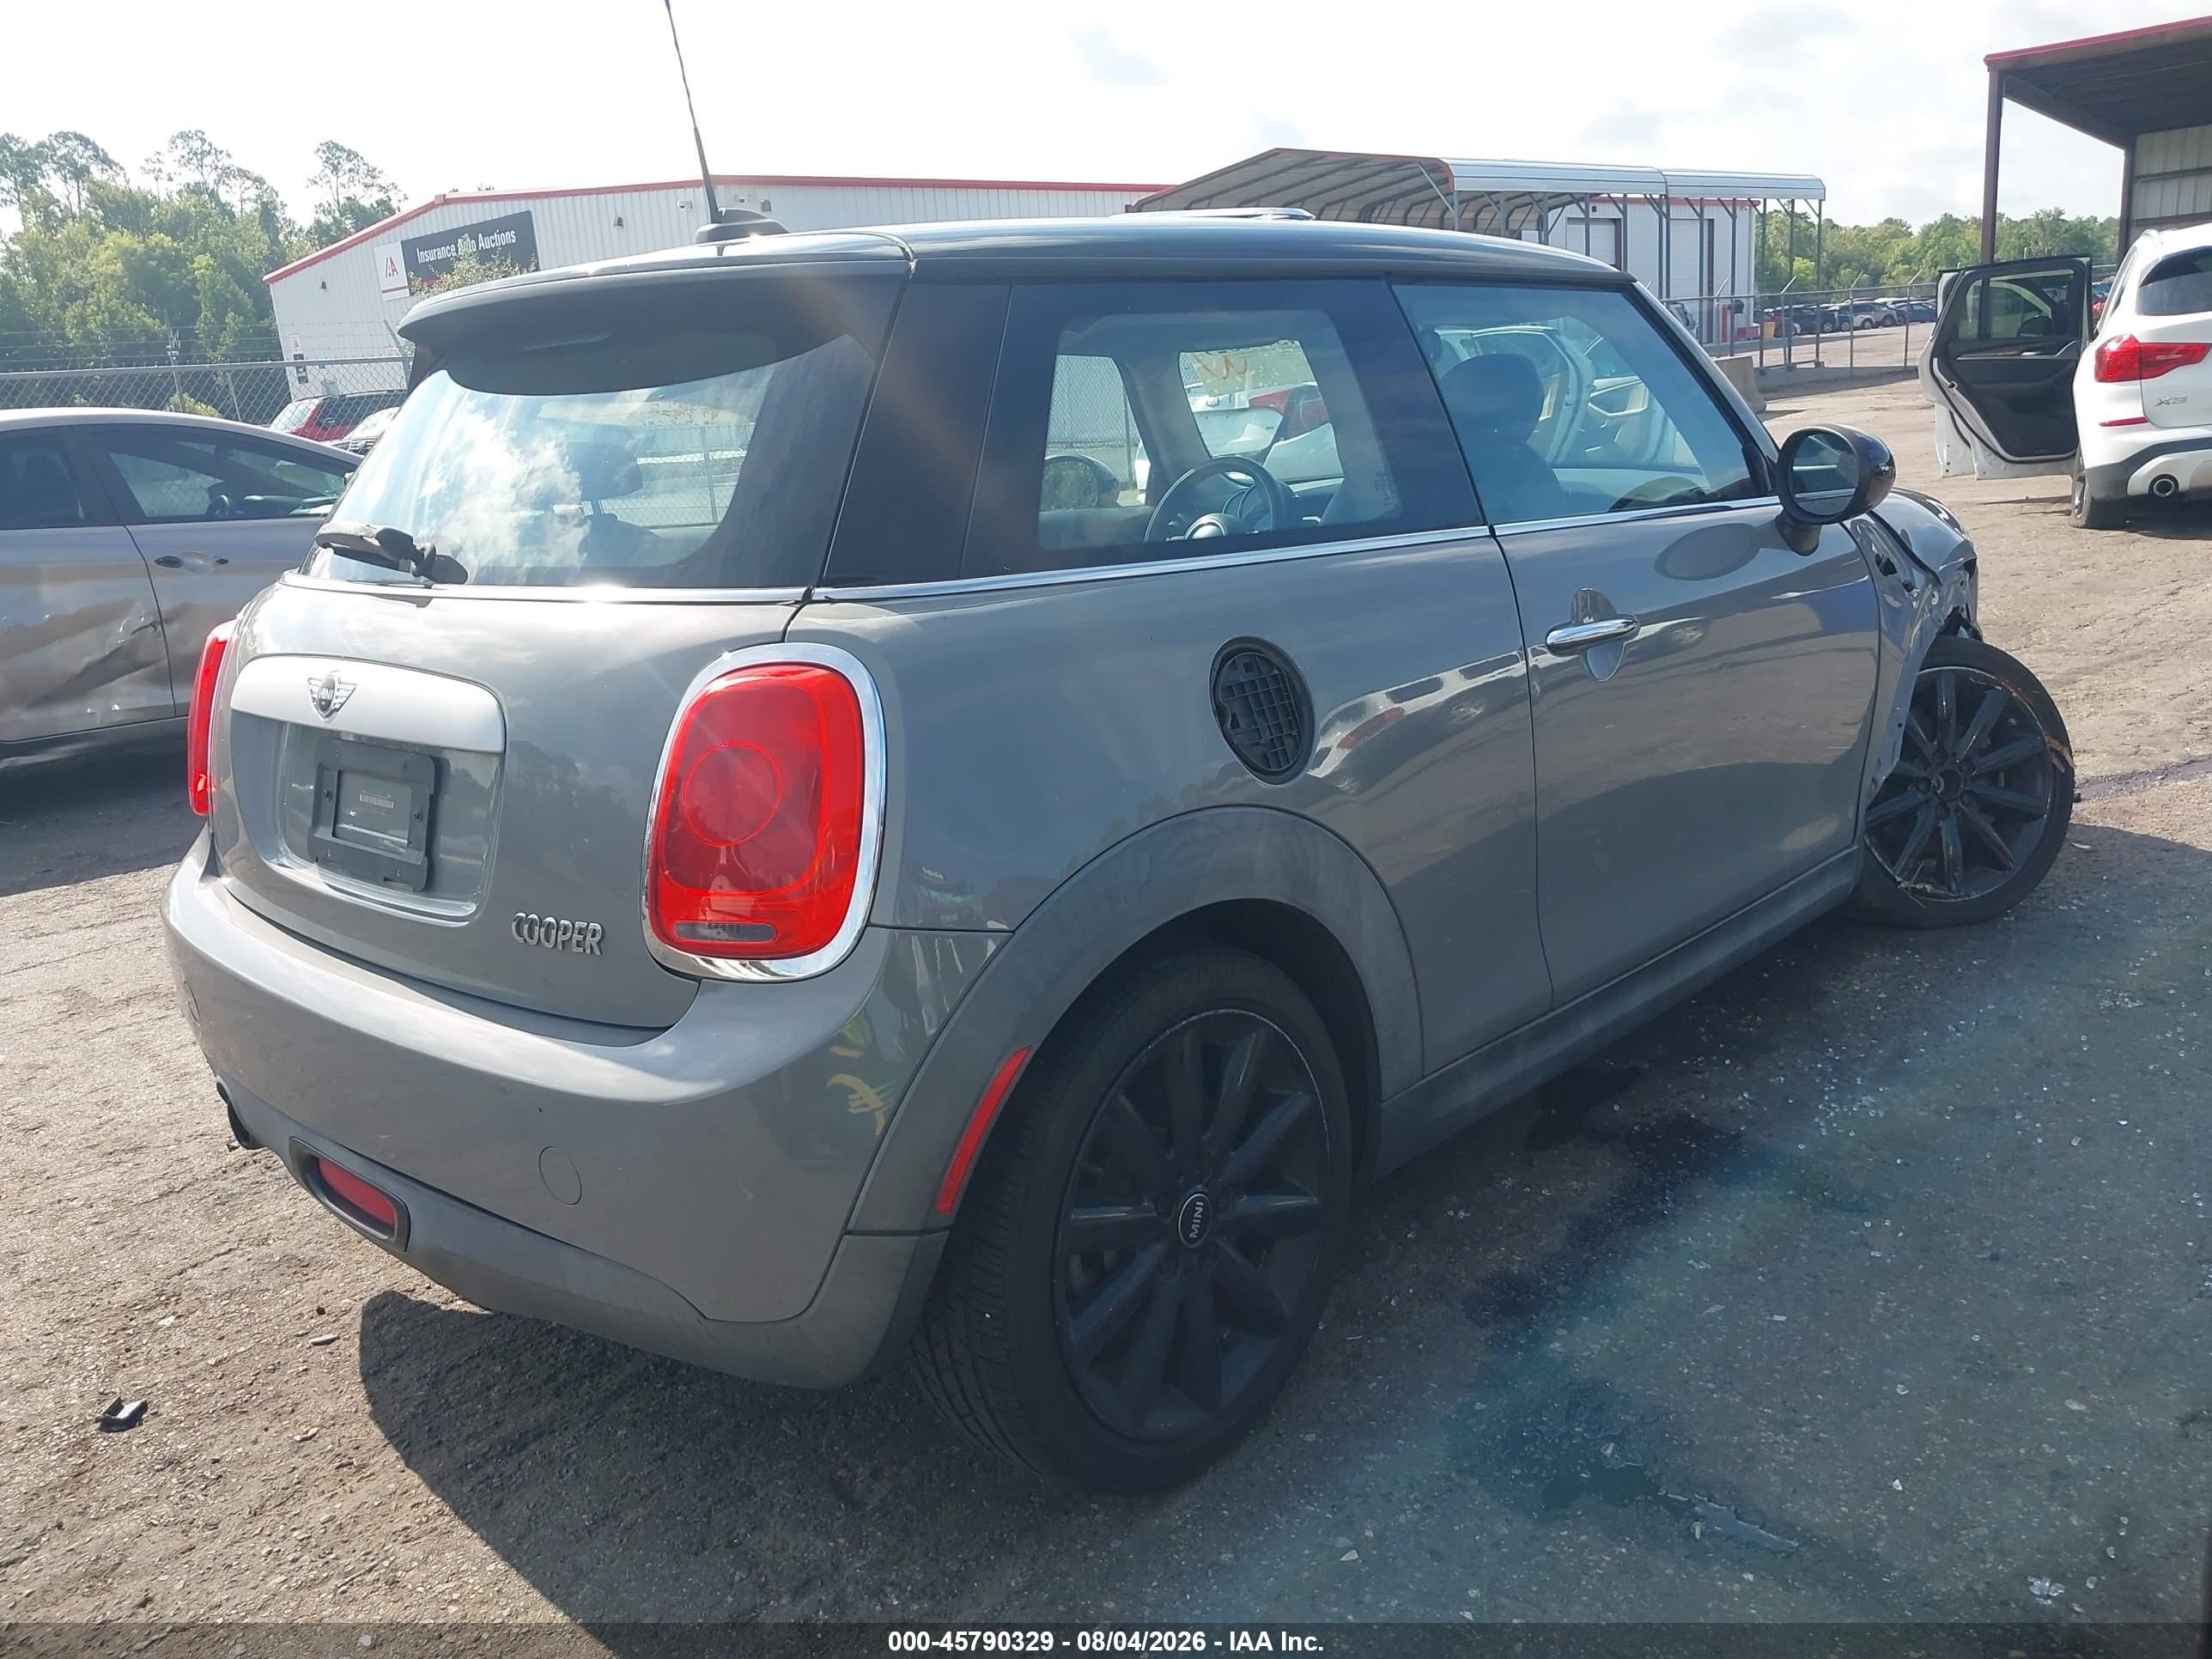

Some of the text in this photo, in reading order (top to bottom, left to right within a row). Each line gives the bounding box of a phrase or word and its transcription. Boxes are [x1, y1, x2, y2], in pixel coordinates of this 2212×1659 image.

[416, 244, 456, 264] Insurance
[478, 229, 516, 251] Auctions
[318, 687, 334, 700] MINI
[512, 912, 602, 955] COOPER
[1188, 1201, 1204, 1238] MINI
